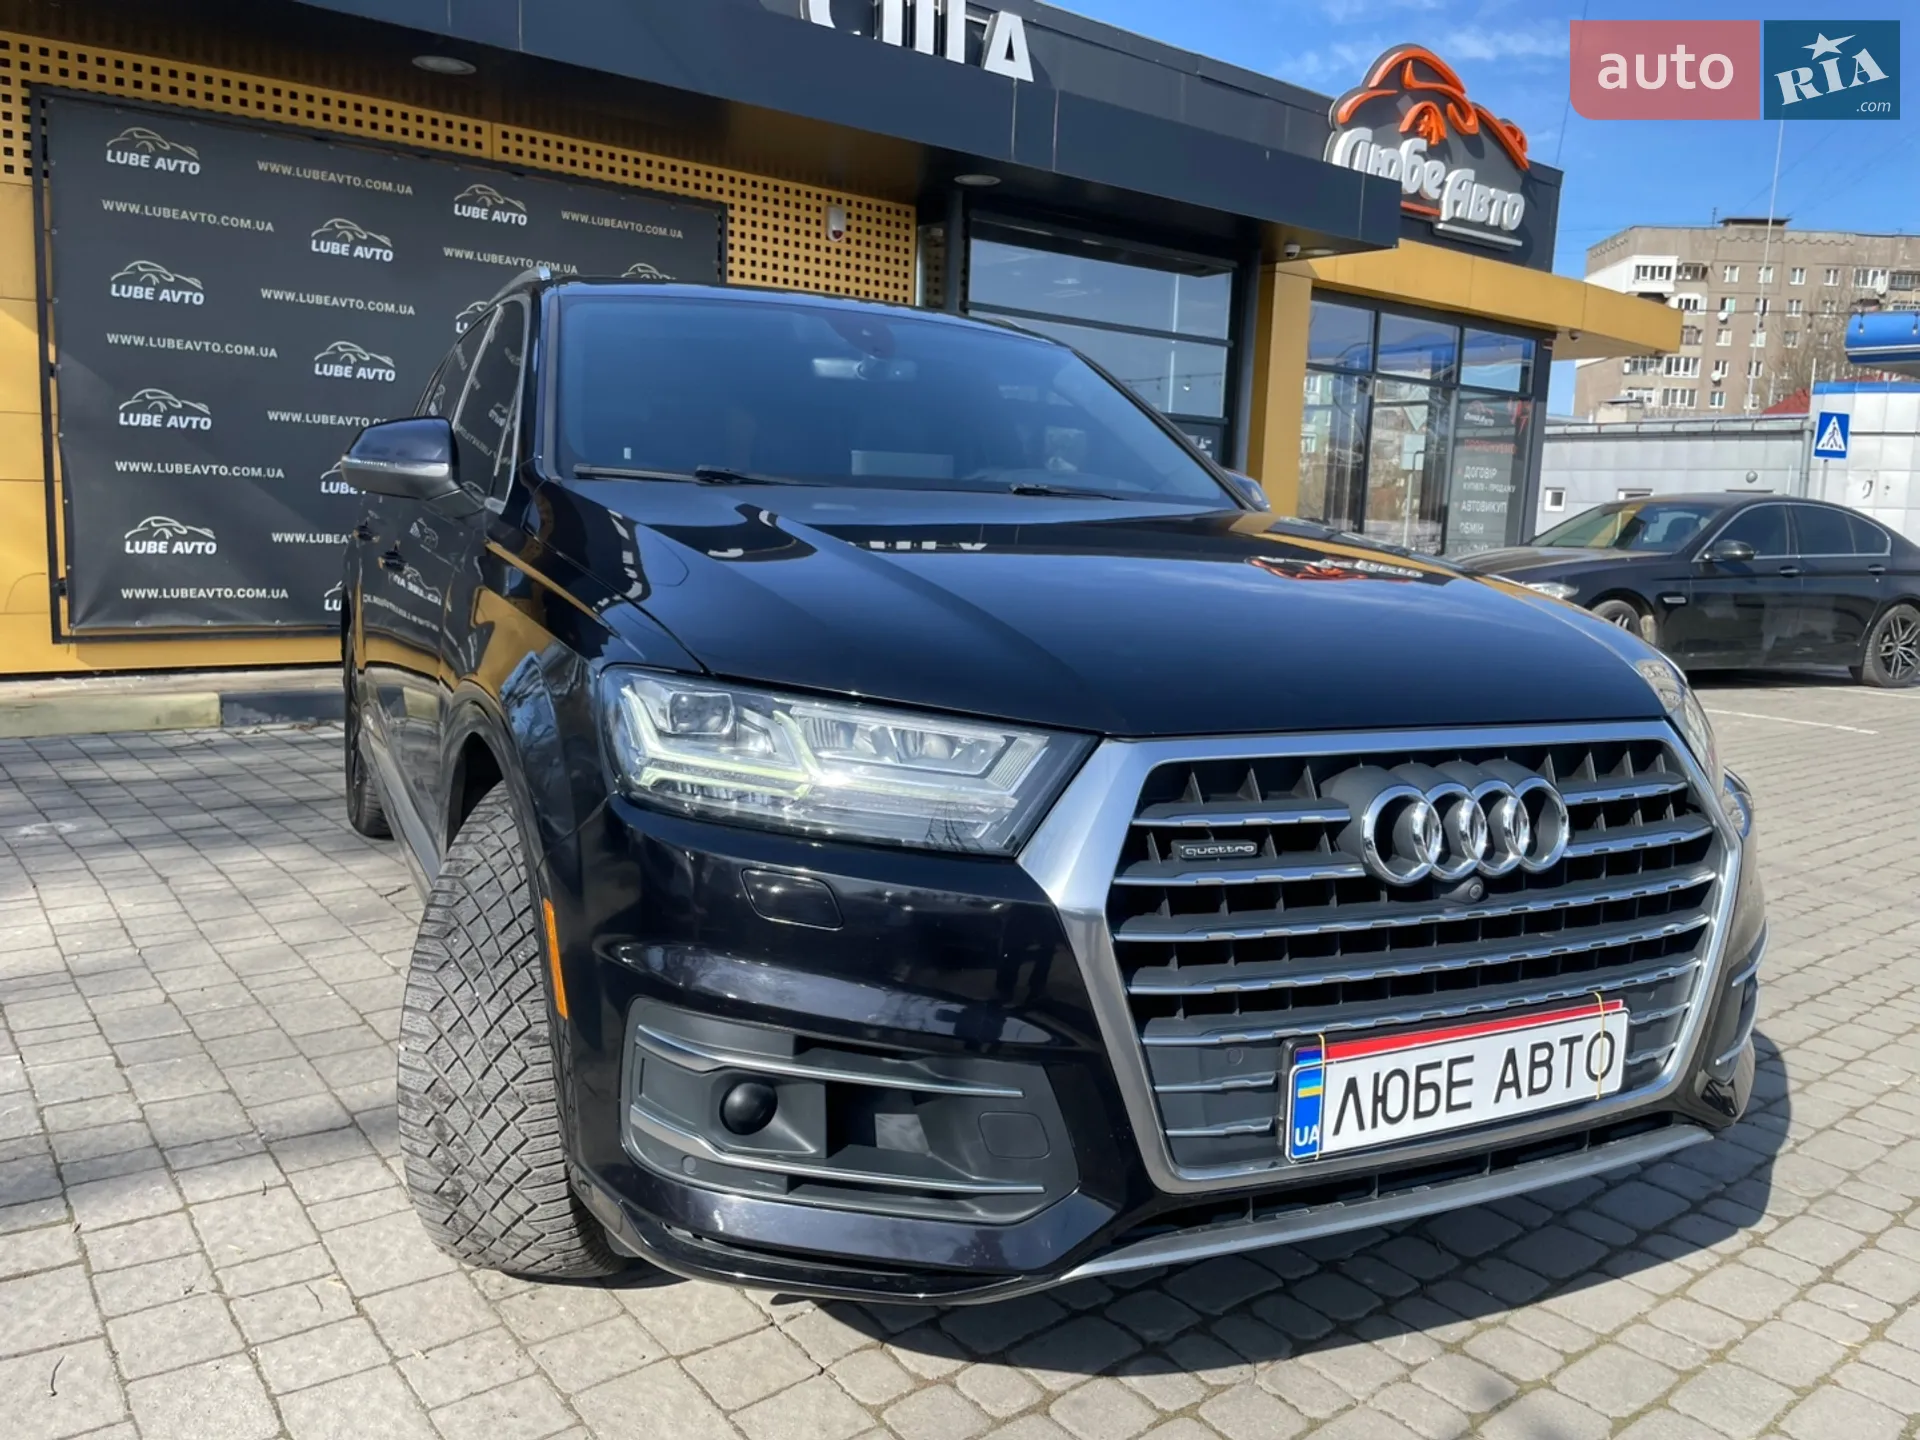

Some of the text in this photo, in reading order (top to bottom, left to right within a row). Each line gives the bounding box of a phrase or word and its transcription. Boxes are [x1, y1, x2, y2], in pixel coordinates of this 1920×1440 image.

[106, 150, 201, 175] LUBE AVTO
[257, 160, 413, 195] WWW.LUBEAVTO.COM.UA
[102, 200, 274, 232] WWW.LUBEAVTO.COM.UA
[454, 204, 528, 226] LUBE AVTO
[561, 211, 683, 238] WWW.LUBEAVTO.COM.UA
[311, 239, 394, 262] LUBE AVTO
[111, 284, 204, 305] LUBE AVTO
[261, 288, 415, 315] WWW.LUBEAVTO.COM.UA
[107, 333, 277, 358] WWW.LUBEAVTO.COM.UA
[314, 363, 396, 382] LUBE AVTO
[119, 413, 212, 430] LUBE AVTO
[115, 461, 285, 479] WWW.LUBEAVTO.COM.UA
[125, 540, 217, 554] LUBE AVTO
[121, 588, 289, 599] WWW.LUBEAVTO.COM.UA
[1185, 845, 1254, 856] quattro
[1333, 1030, 1616, 1136] ЛЮБЕ АВТО
[1294, 1124, 1319, 1147] UA
